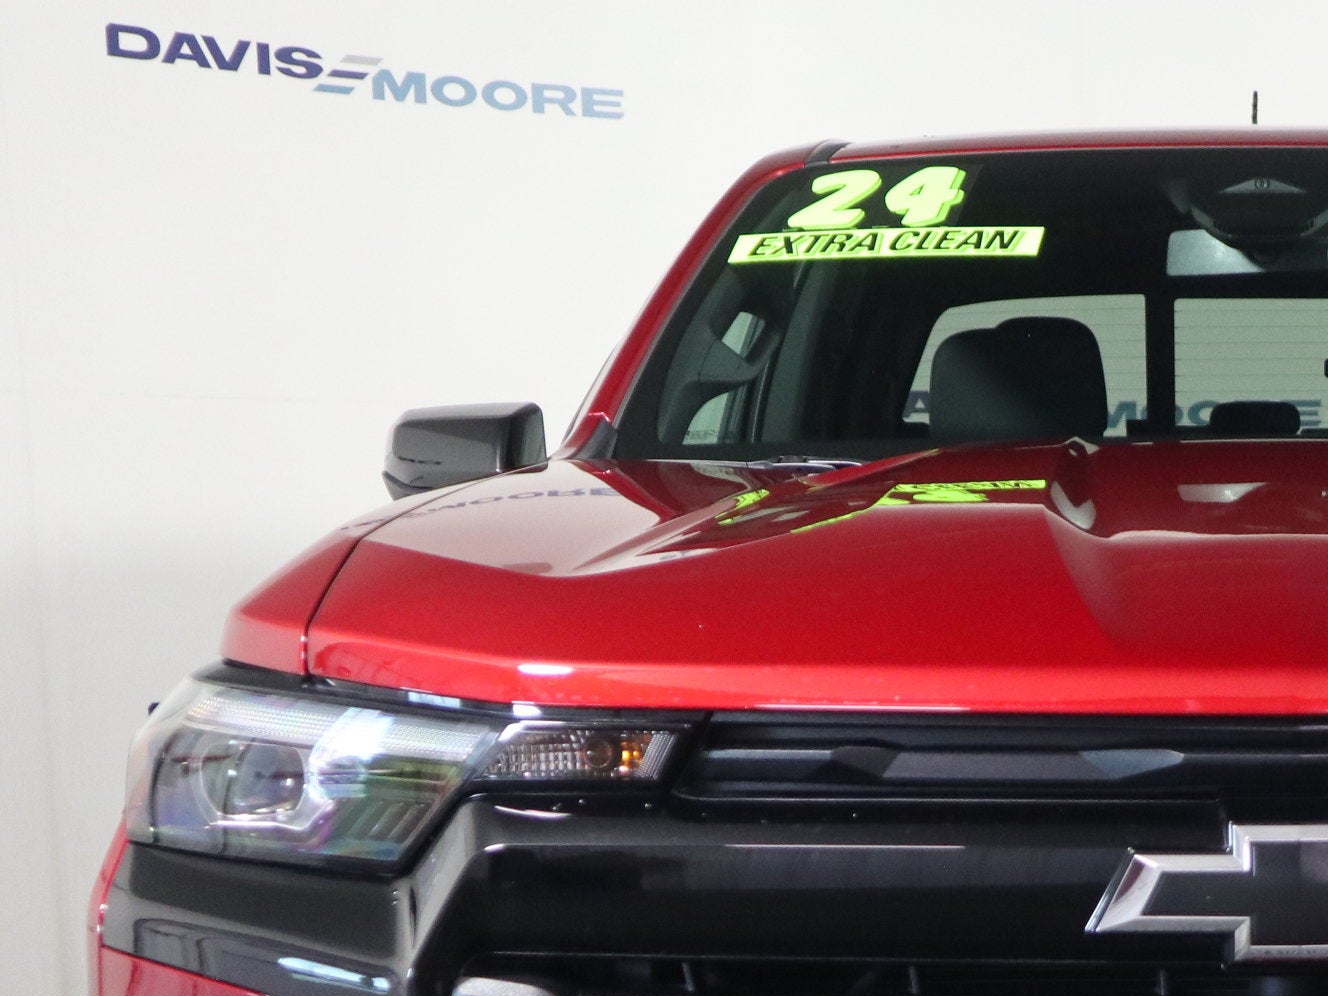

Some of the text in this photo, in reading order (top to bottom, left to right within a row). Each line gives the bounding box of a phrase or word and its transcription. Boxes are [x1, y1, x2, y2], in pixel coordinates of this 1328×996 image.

[105, 22, 625, 120] DAVIS MOORE
[787, 166, 967, 230] 24
[748, 230, 1023, 257] EXTRA CLEAN
